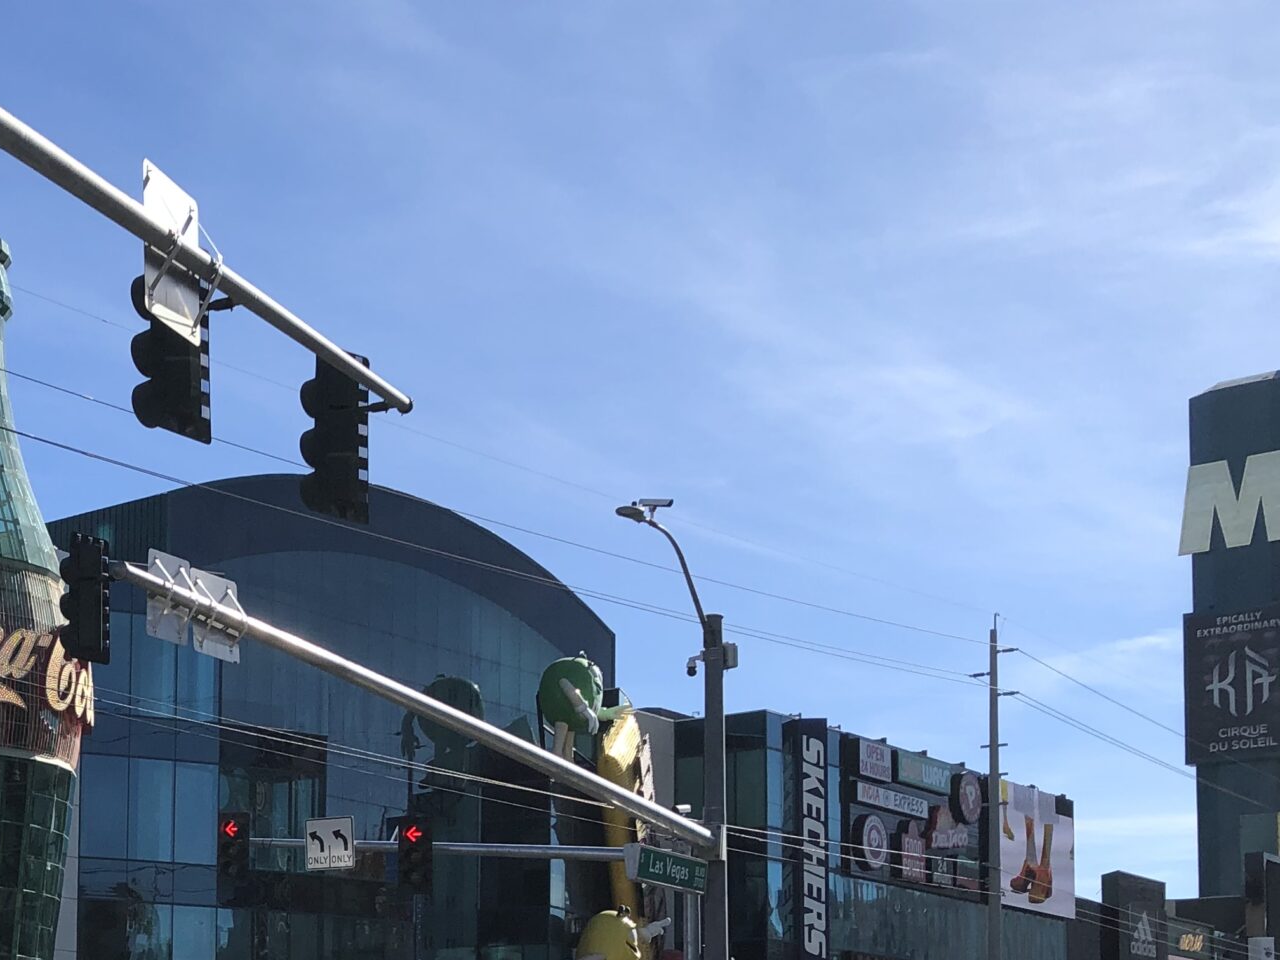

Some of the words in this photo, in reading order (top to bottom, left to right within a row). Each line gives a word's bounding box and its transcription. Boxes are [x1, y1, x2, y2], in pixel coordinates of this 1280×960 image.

[1178, 450, 1280, 556] M
[1216, 611, 1262, 625] EPICALLY
[1196, 619, 1280, 638] EXTRAORDINARY
[1218, 723, 1268, 738] CIRQUE
[866, 744, 885, 762] OPEN
[1209, 740, 1228, 752] DU
[1231, 737, 1279, 750] SOLEIL
[861, 784, 880, 798] INDIA
[893, 793, 924, 815] EXPRESS
[802, 735, 826, 959] SKECHERS
[308, 856, 328, 865] ONLY
[332, 854, 352, 864] ONLY
[649, 853, 663, 874] Las
[666, 857, 689, 883] Vegas
[1130, 941, 1157, 958] adidas
